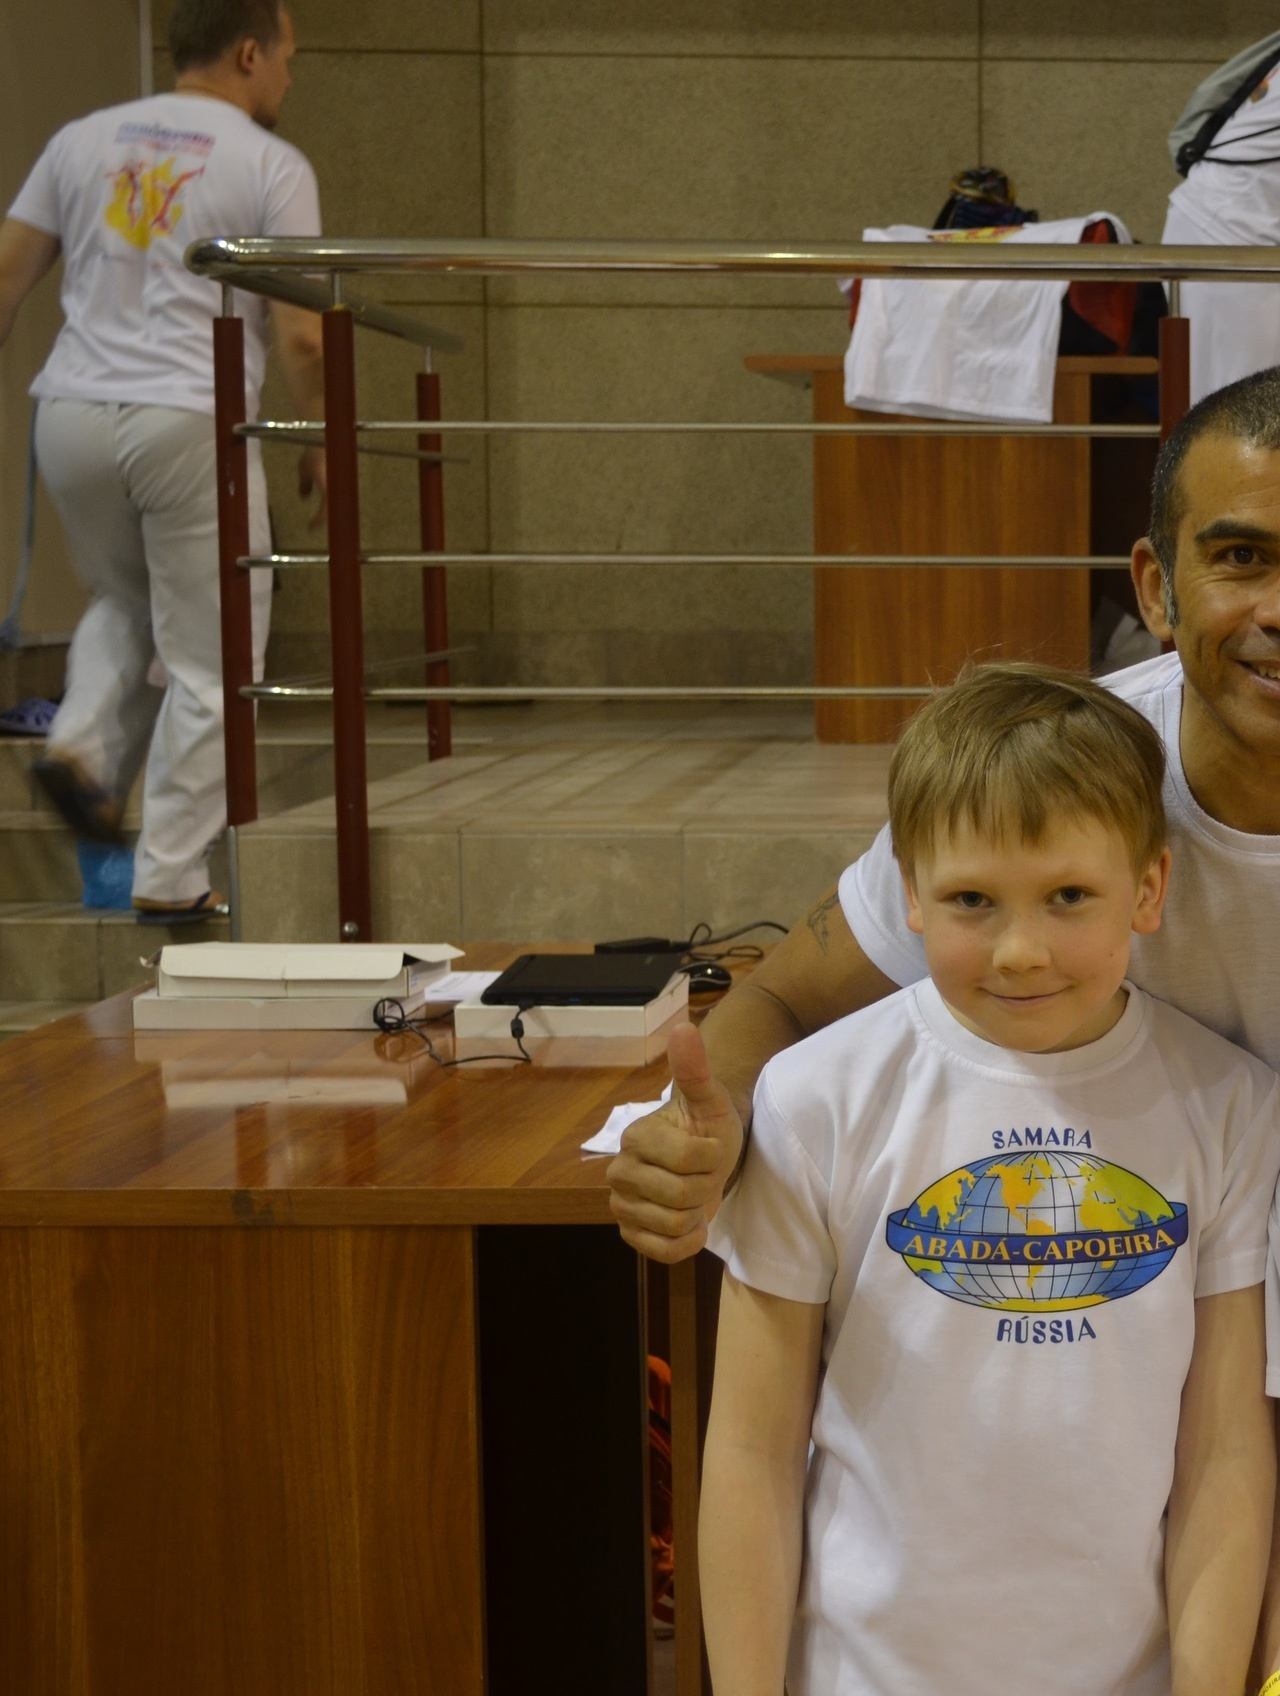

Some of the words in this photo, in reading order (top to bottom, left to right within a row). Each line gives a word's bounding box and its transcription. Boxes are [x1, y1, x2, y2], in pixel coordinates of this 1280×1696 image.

[991, 1126, 1093, 1150] SAMARA
[903, 1228, 1176, 1262] ABADÁ-CAPOEIRA
[996, 1315, 1097, 1344] RÚSSIA
